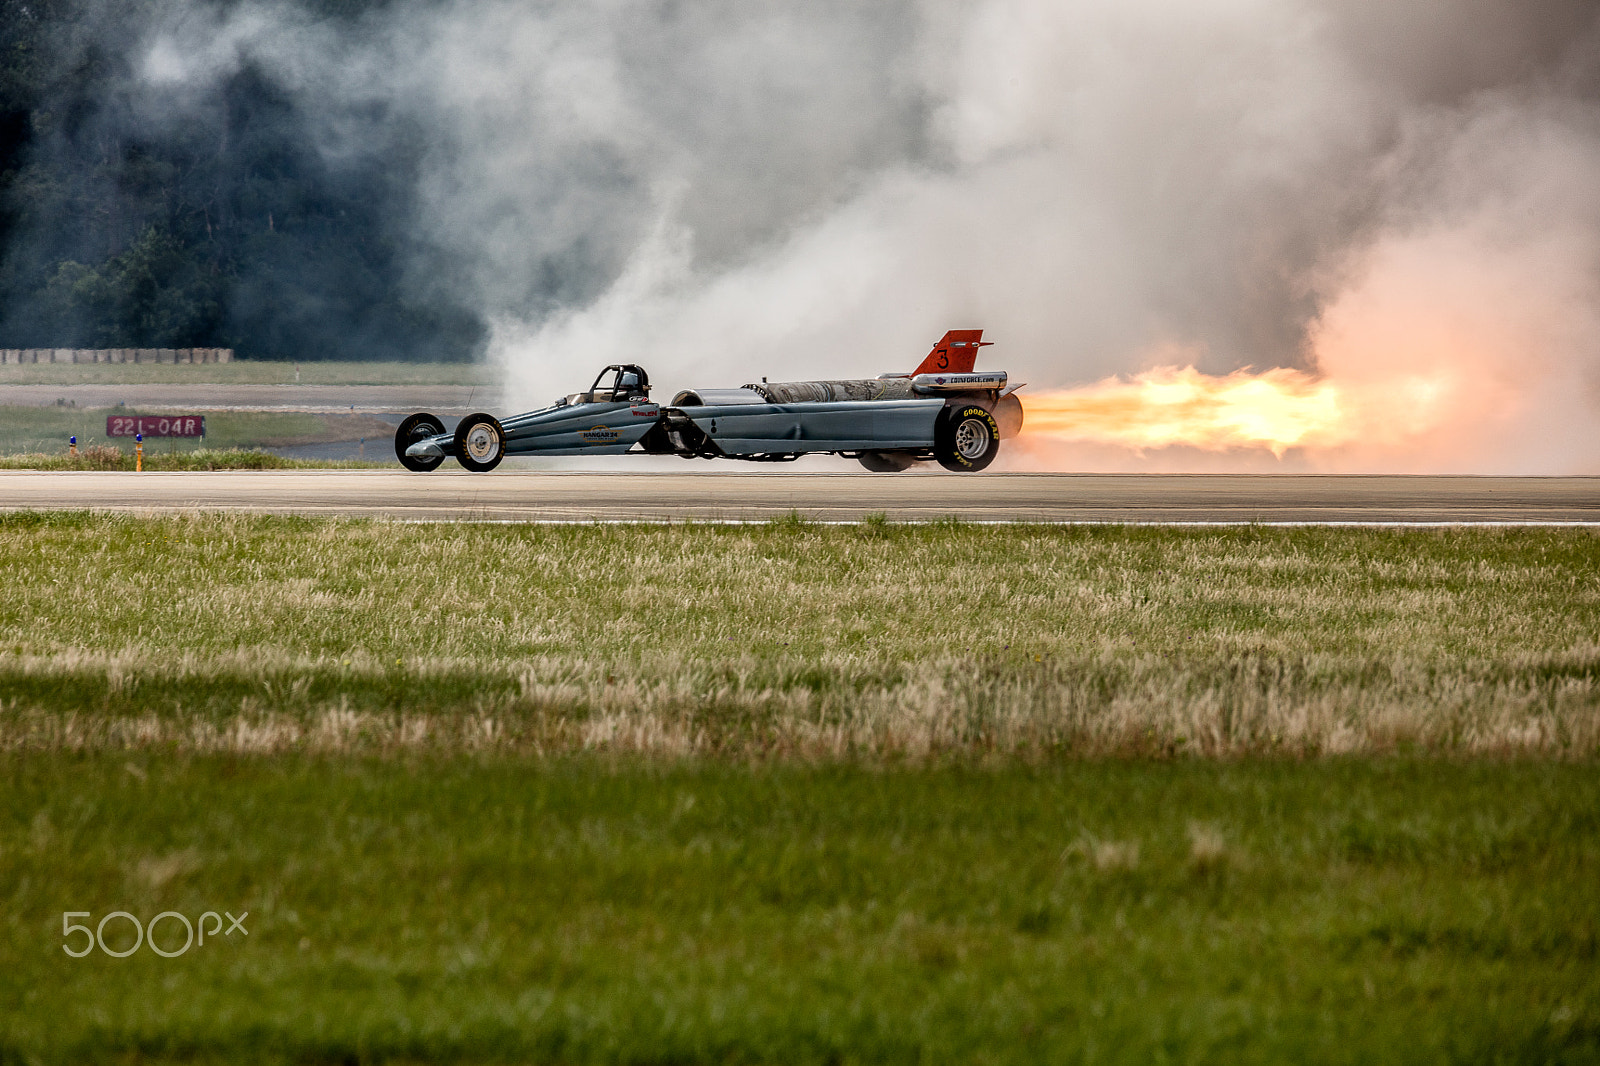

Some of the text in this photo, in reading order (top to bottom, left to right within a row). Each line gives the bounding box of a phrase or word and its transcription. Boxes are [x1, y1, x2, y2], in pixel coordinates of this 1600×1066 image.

[936, 349, 949, 369] 3
[112, 418, 196, 435] 22L-04R
[963, 408, 999, 440] GOODYEAR
